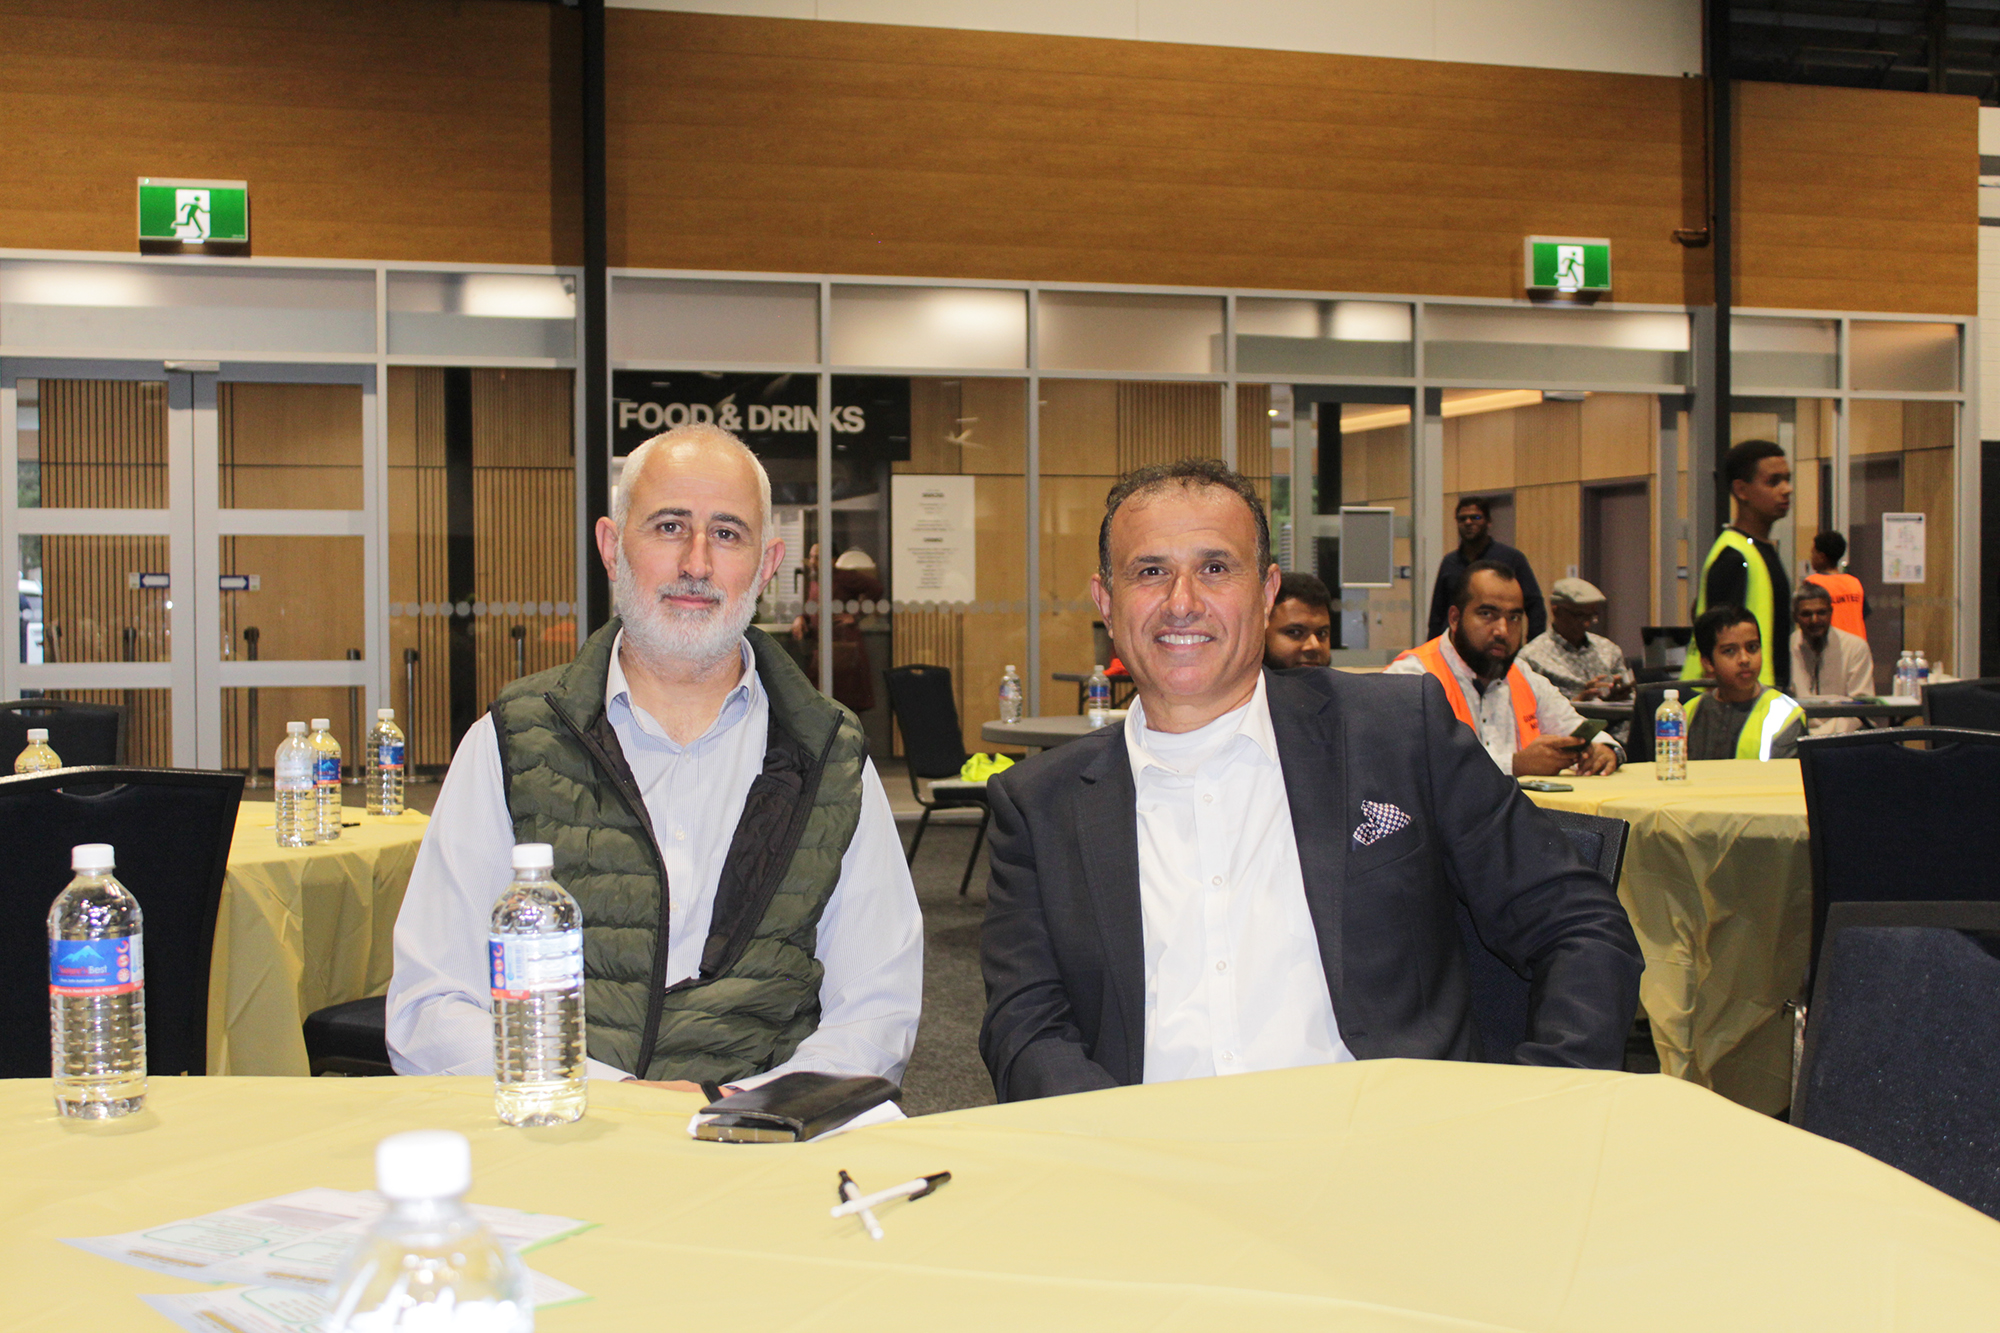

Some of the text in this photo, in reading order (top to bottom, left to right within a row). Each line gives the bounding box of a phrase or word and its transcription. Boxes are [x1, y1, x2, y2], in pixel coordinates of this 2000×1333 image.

[618, 402, 866, 432] FOOD & DRINKS
